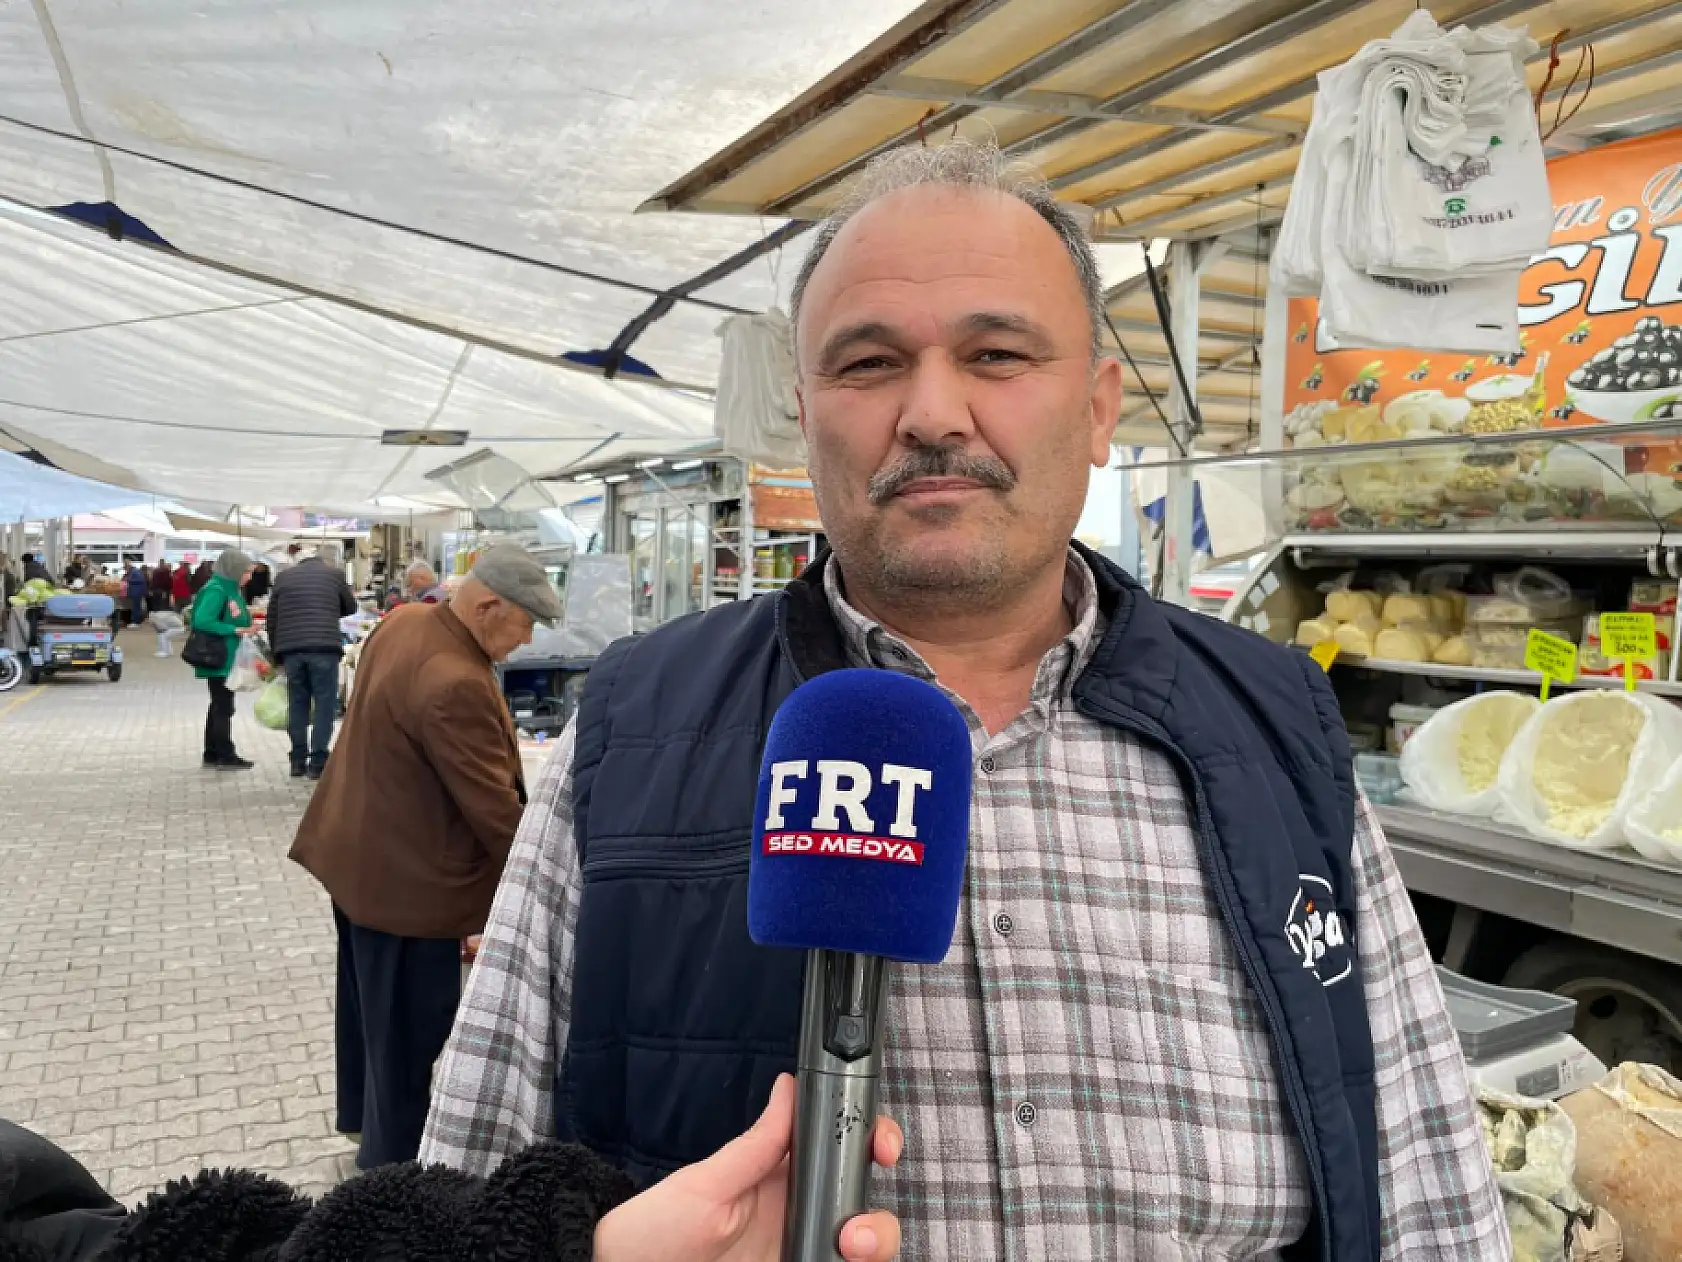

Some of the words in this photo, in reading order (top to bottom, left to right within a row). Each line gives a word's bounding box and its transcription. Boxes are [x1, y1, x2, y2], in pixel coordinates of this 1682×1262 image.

[765, 760, 932, 836] FRT
[769, 835, 813, 851] SED
[819, 836, 917, 862] MEDYA
